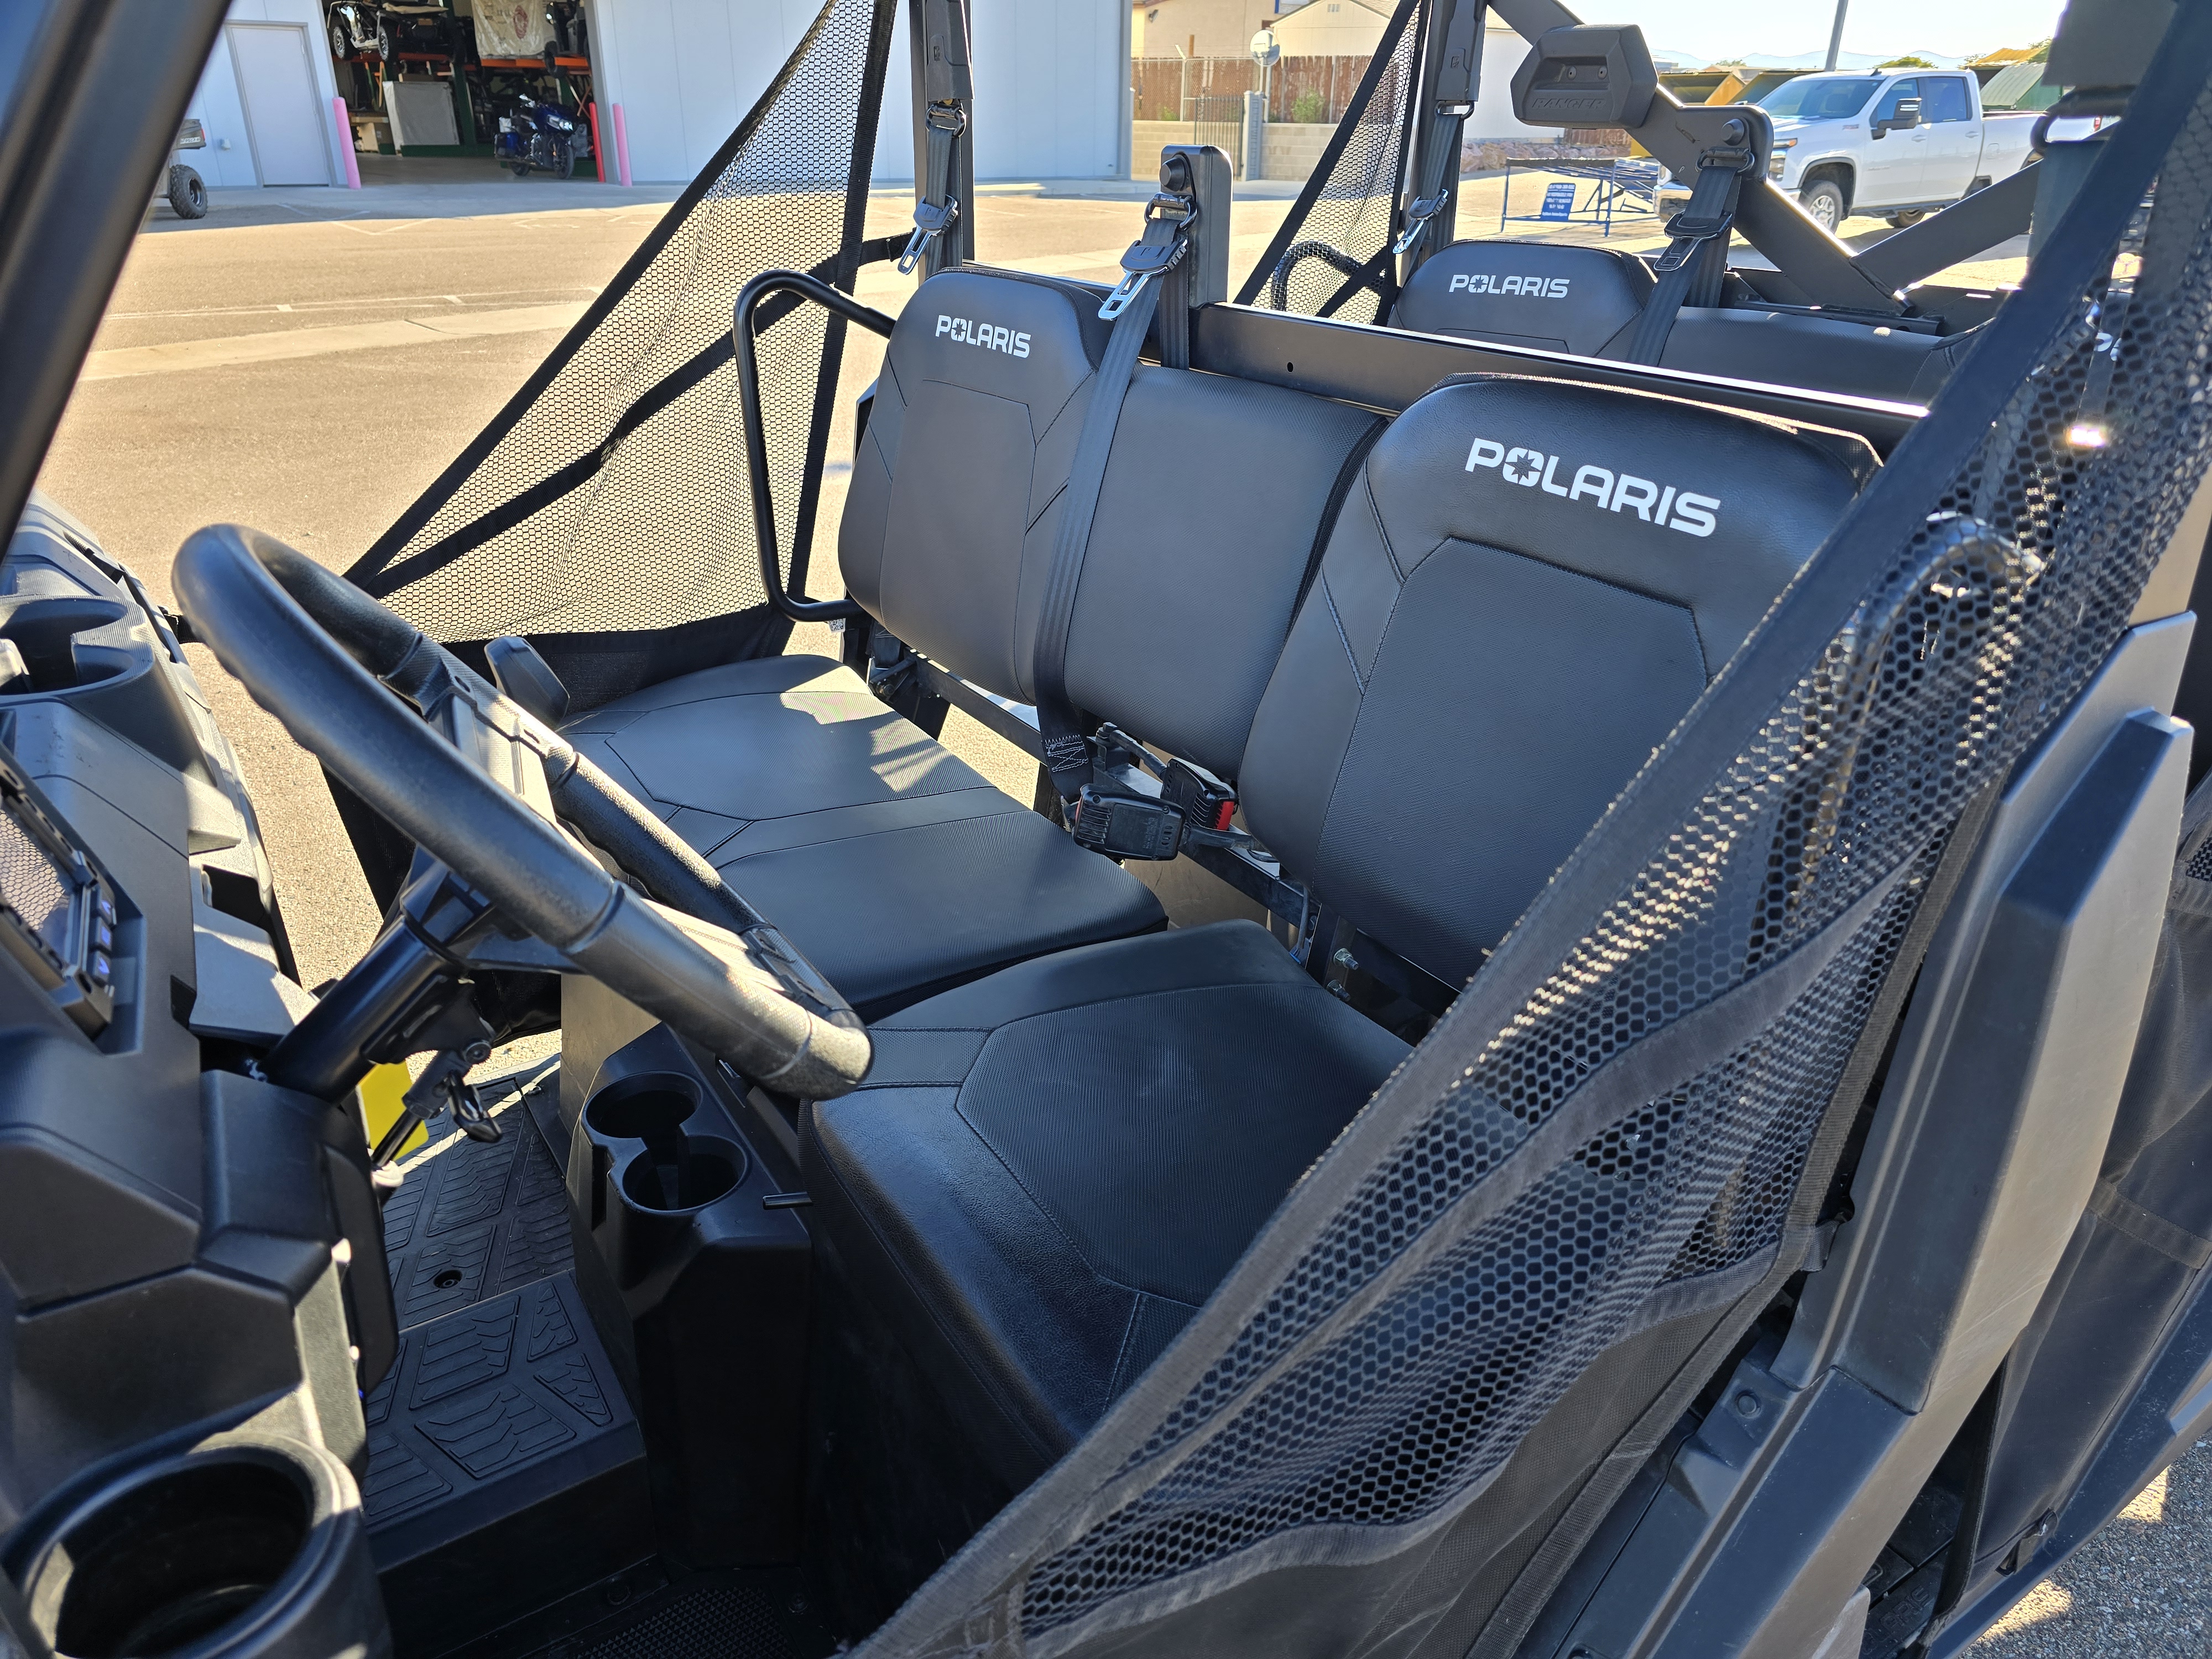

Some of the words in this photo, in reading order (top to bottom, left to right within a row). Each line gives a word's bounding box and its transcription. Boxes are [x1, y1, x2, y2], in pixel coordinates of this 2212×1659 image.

[1532, 98, 1605, 109] RANGER
[1449, 274, 1570, 298] POLARIS
[935, 315, 1031, 358] POLARIS
[1465, 437, 1721, 537] POLARIS
[1861, 1585, 1929, 1655] OLARIS
